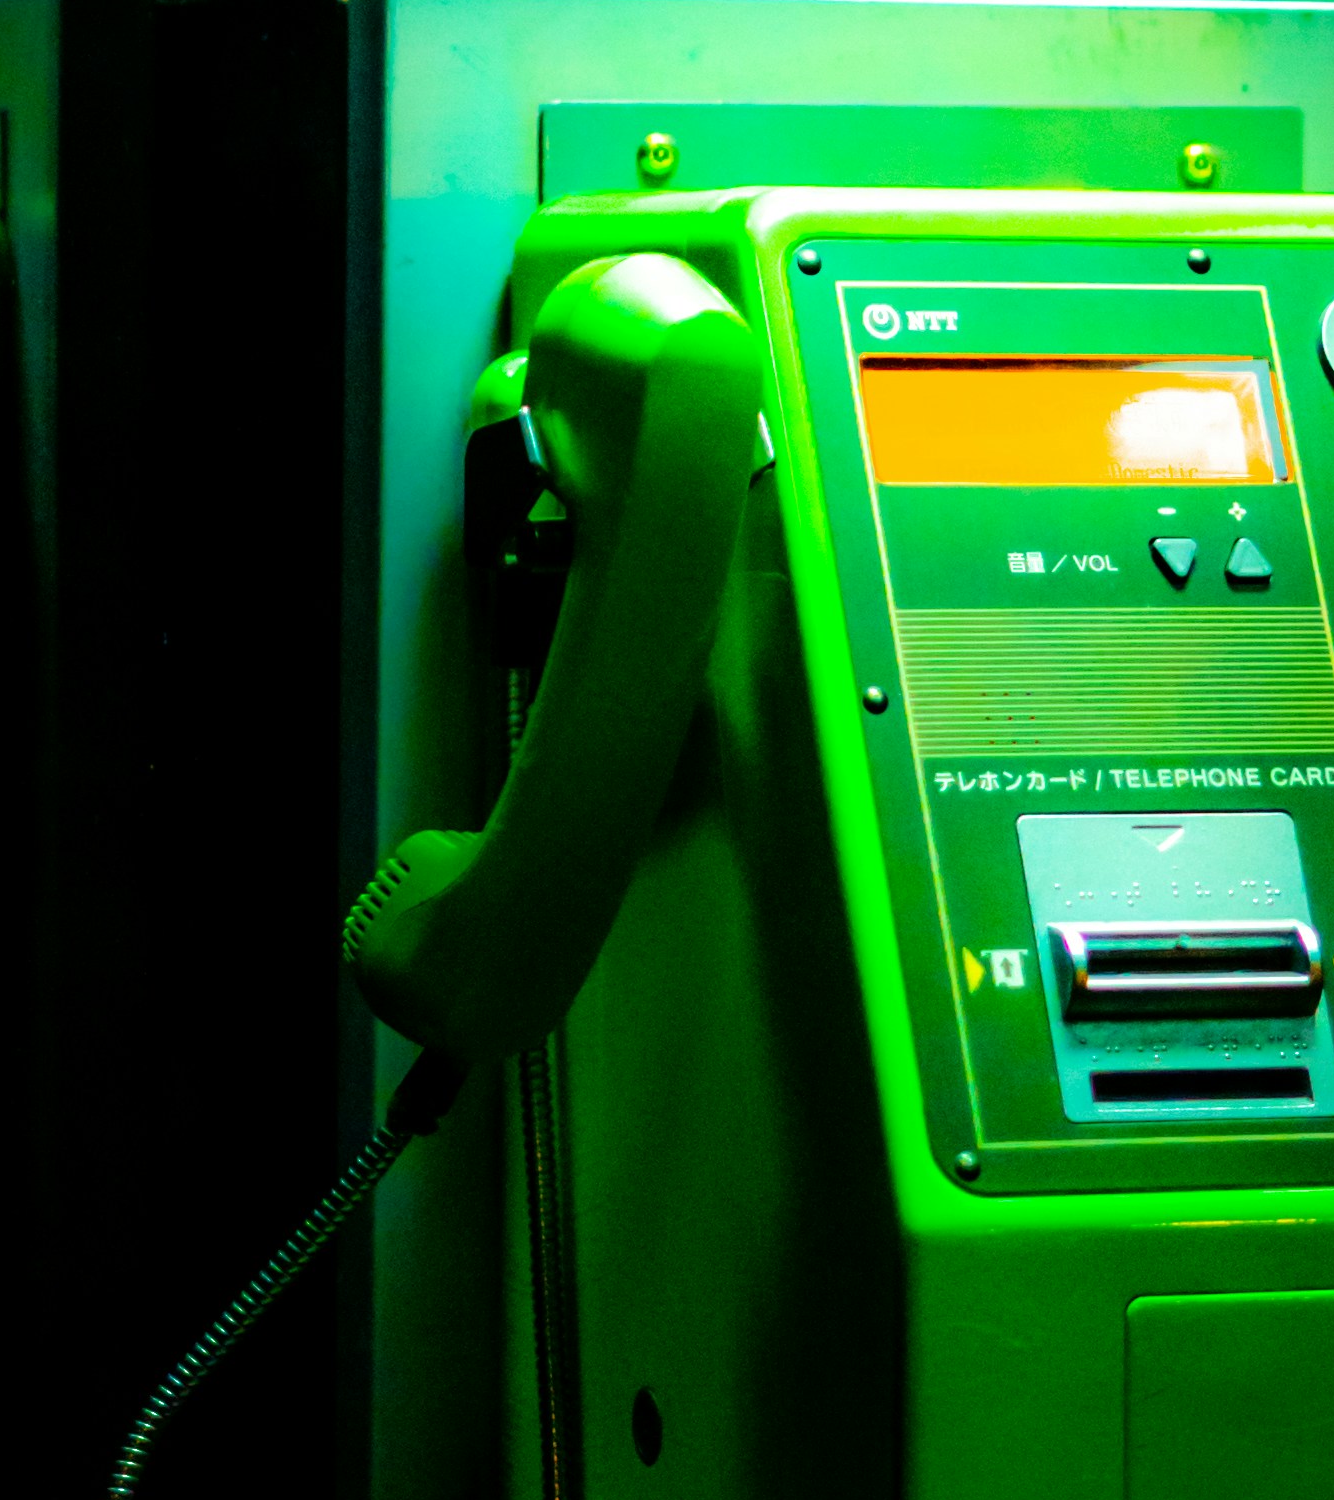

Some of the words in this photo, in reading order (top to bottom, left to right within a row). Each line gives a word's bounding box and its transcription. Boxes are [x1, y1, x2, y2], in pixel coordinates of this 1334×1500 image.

[907, 311, 960, 332] NTT
[1007, 551, 1046, 574] 音量
[1072, 553, 1119, 573] VOL
[933, 769, 1088, 792] テレホンカード
[1109, 767, 1261, 788] TELEPHONE
